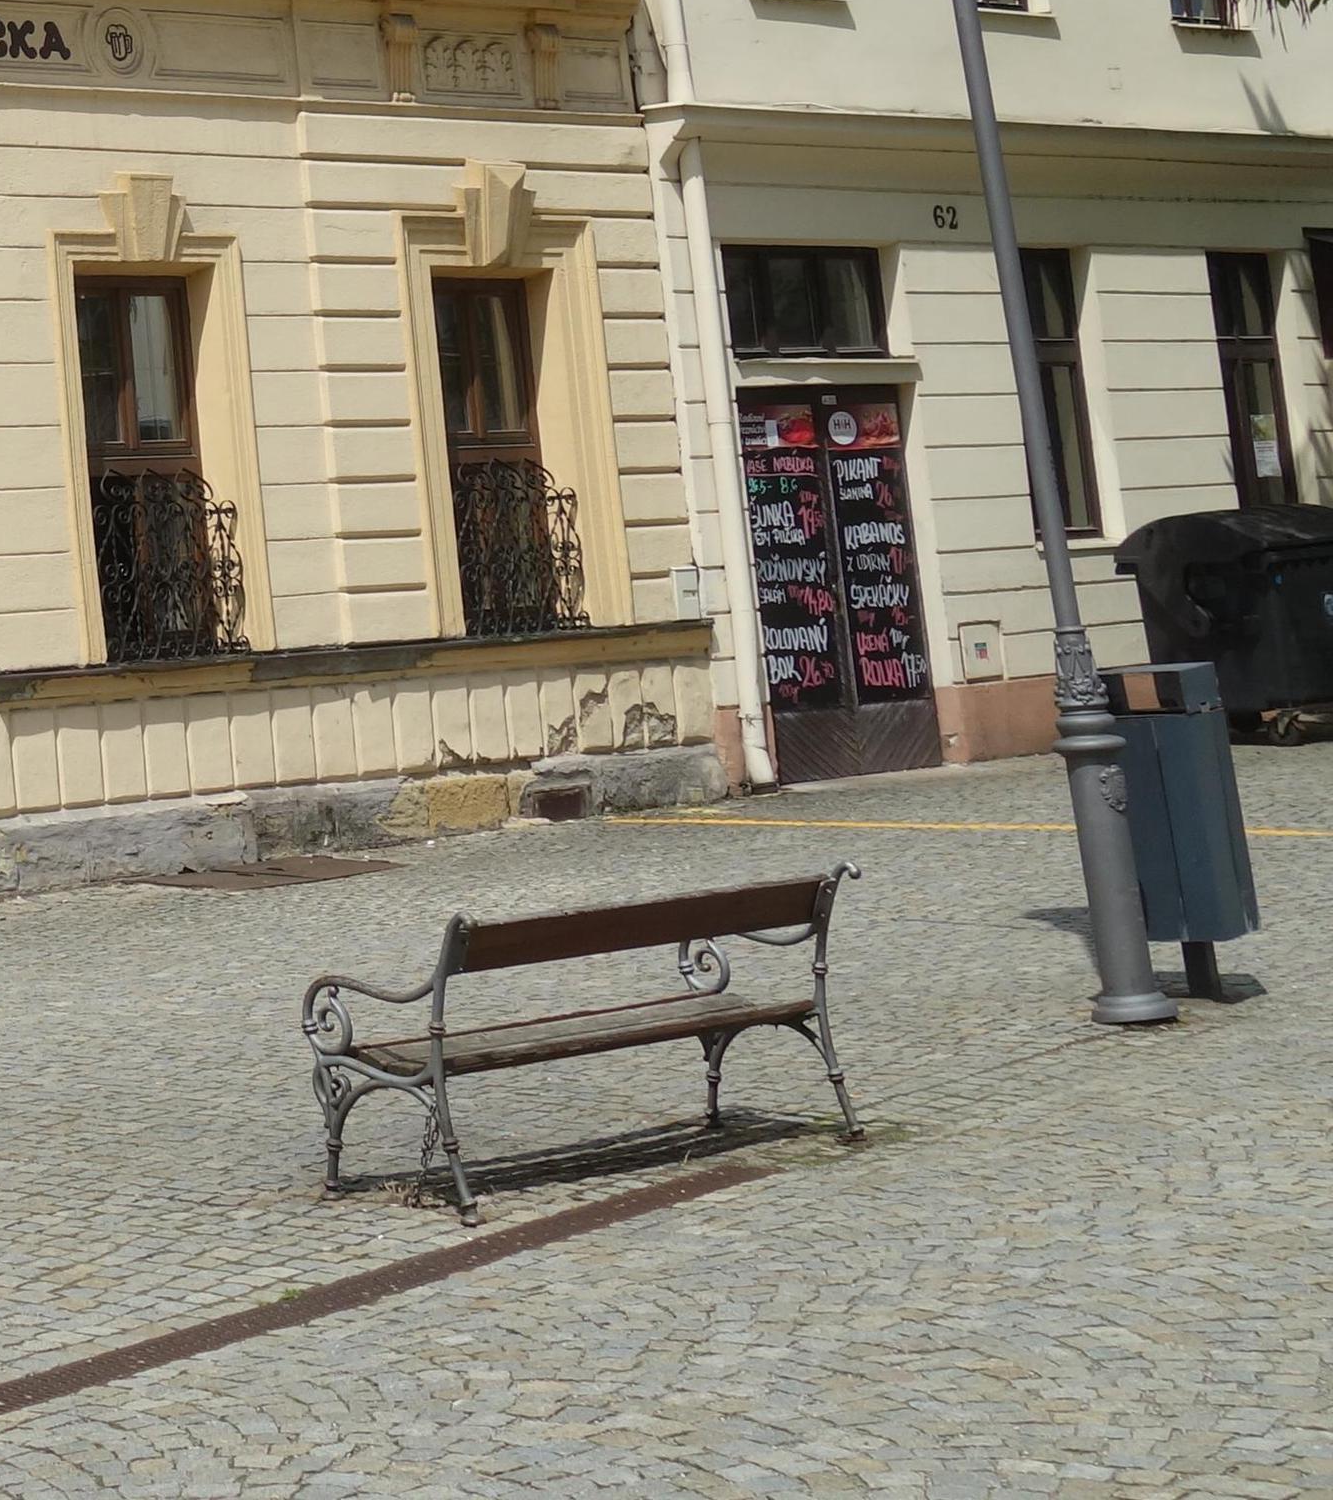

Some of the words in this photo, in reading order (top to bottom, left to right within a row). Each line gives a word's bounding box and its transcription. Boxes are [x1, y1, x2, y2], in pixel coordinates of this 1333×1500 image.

[933, 204, 958, 230] 62
[833, 456, 882, 486] PIKANT
[844, 521, 906, 550] KABANOS
[767, 655, 802, 685] BOK
[859, 657, 906, 689] ROLKA
